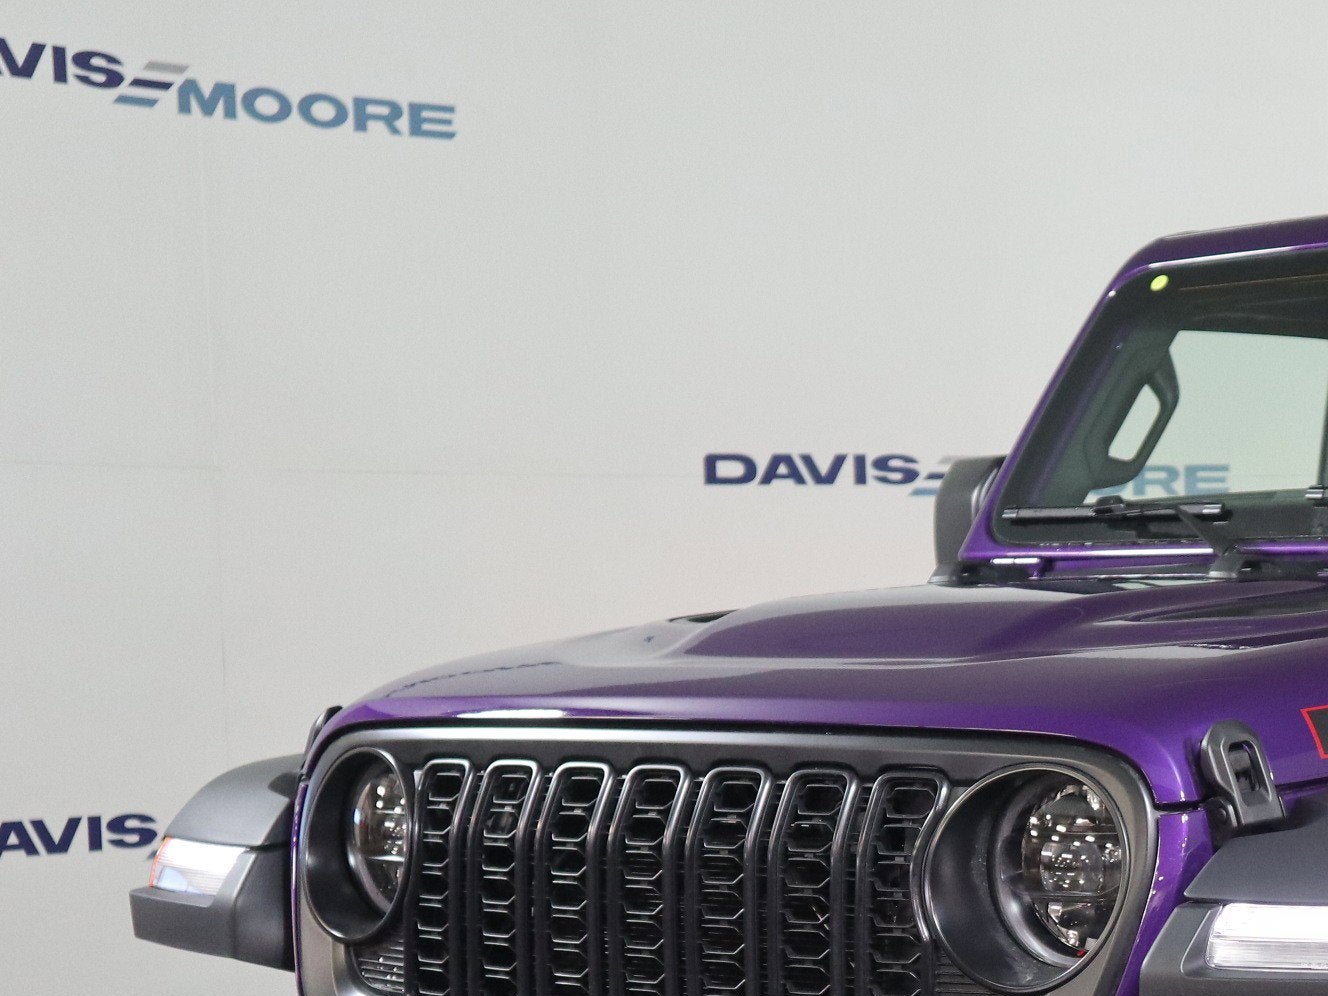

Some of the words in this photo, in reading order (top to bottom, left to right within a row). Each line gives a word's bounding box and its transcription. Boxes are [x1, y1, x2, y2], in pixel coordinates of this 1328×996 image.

[0, 36, 125, 89] VIS
[177, 78, 458, 140] MOORE
[702, 452, 920, 486] DAVIS
